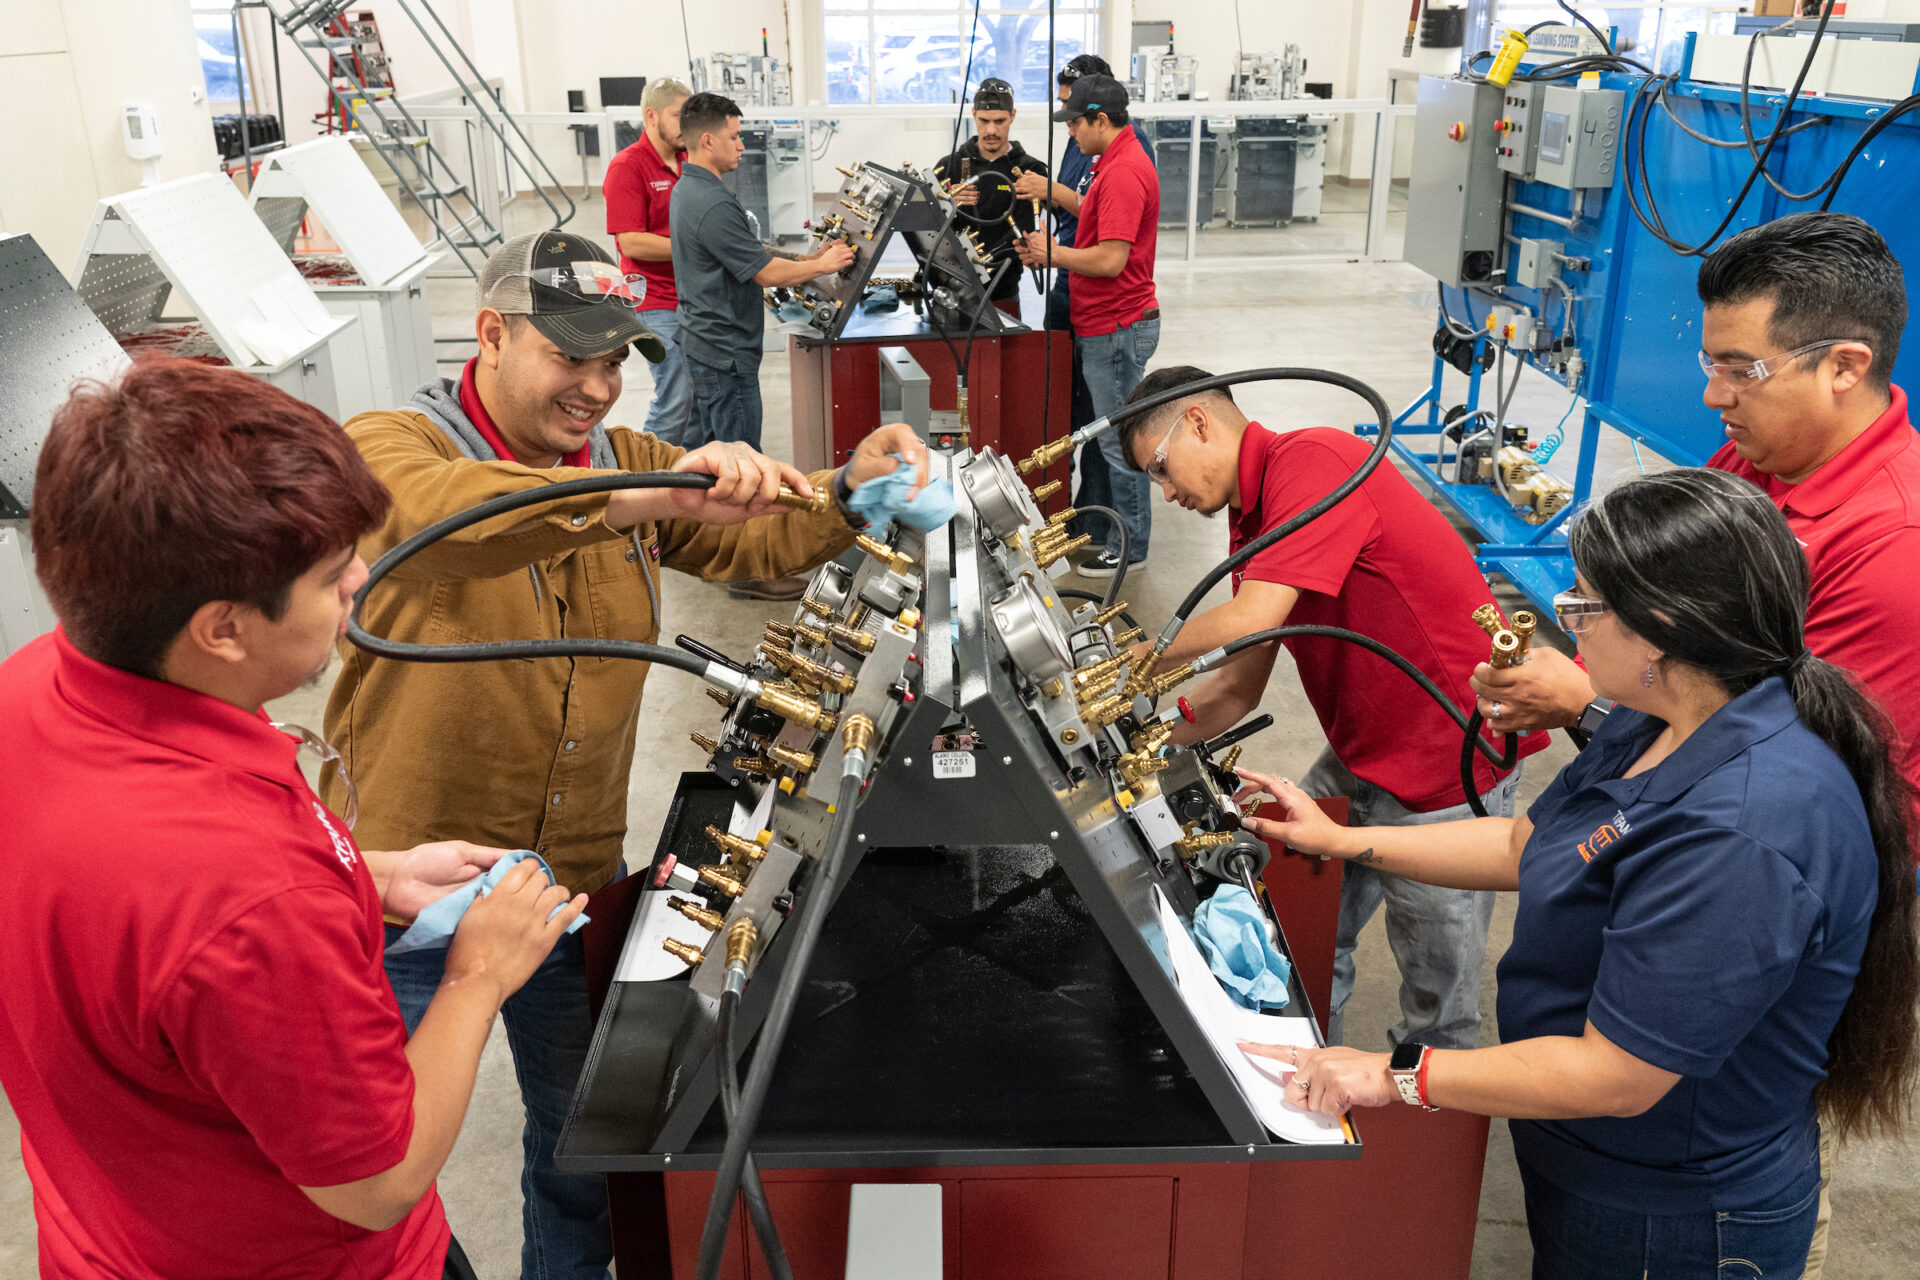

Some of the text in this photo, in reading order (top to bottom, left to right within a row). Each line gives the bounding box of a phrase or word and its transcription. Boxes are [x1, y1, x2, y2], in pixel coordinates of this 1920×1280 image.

[1532, 33, 1557, 47] LEARNING
[1558, 34, 1579, 48] SYSTEM
[1584, 119, 1598, 148] 4
